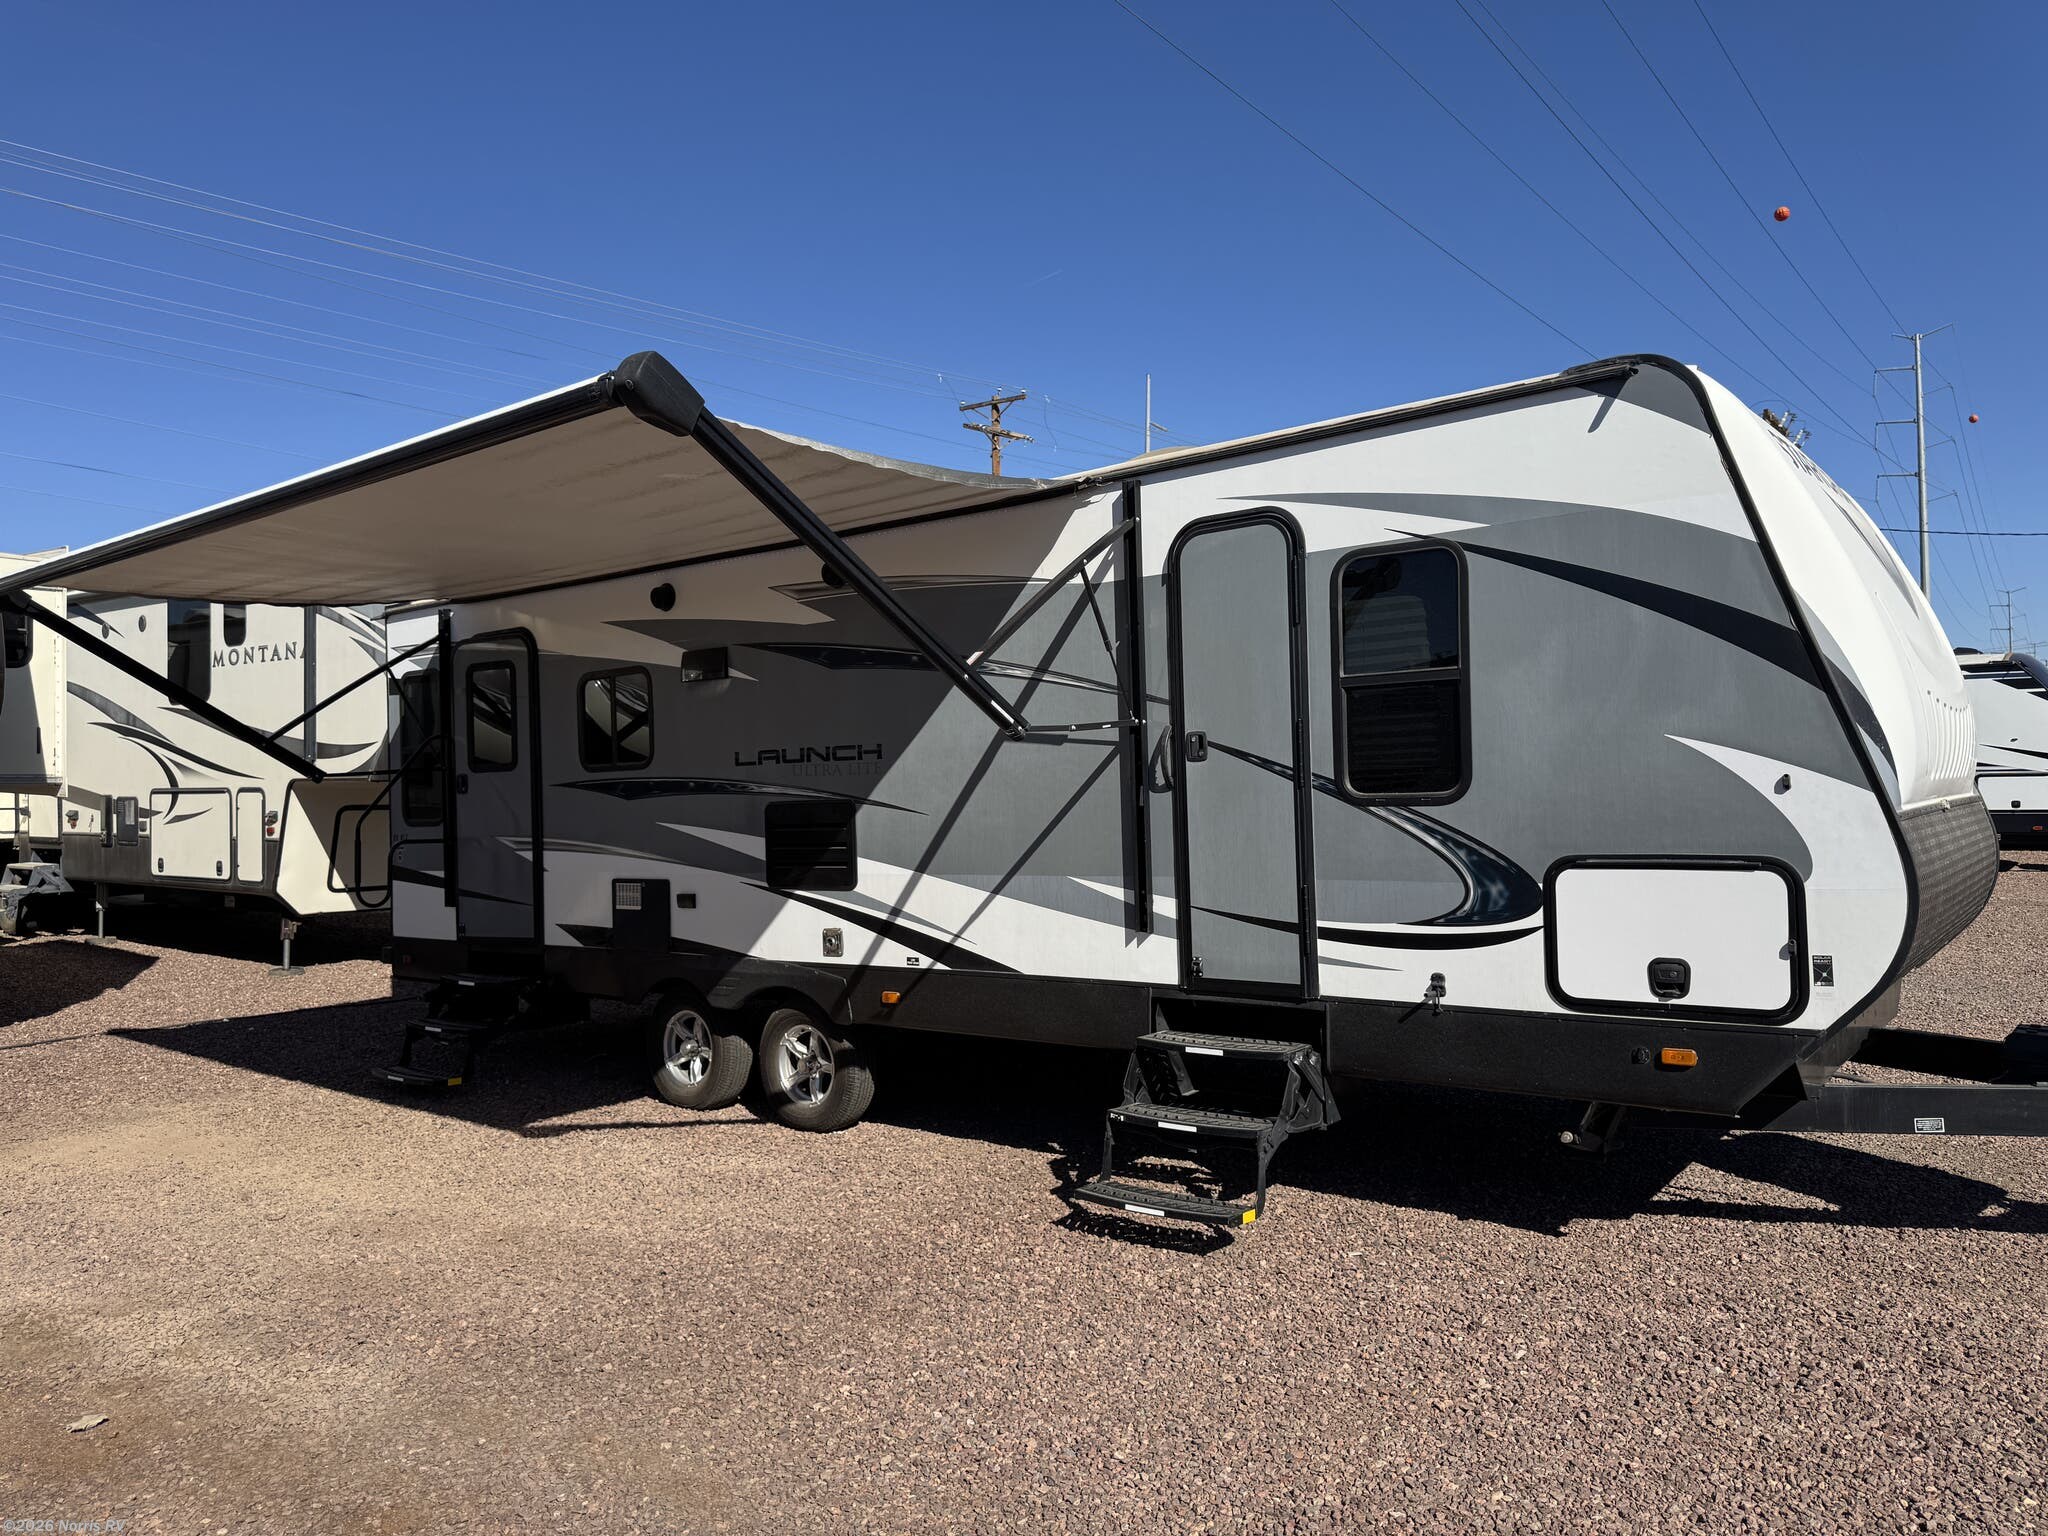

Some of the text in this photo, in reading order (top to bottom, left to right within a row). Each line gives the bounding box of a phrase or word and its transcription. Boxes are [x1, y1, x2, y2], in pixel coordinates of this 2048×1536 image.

[734, 743, 883, 767] LAUNCH
[792, 760, 881, 777] ULTRA LITE
